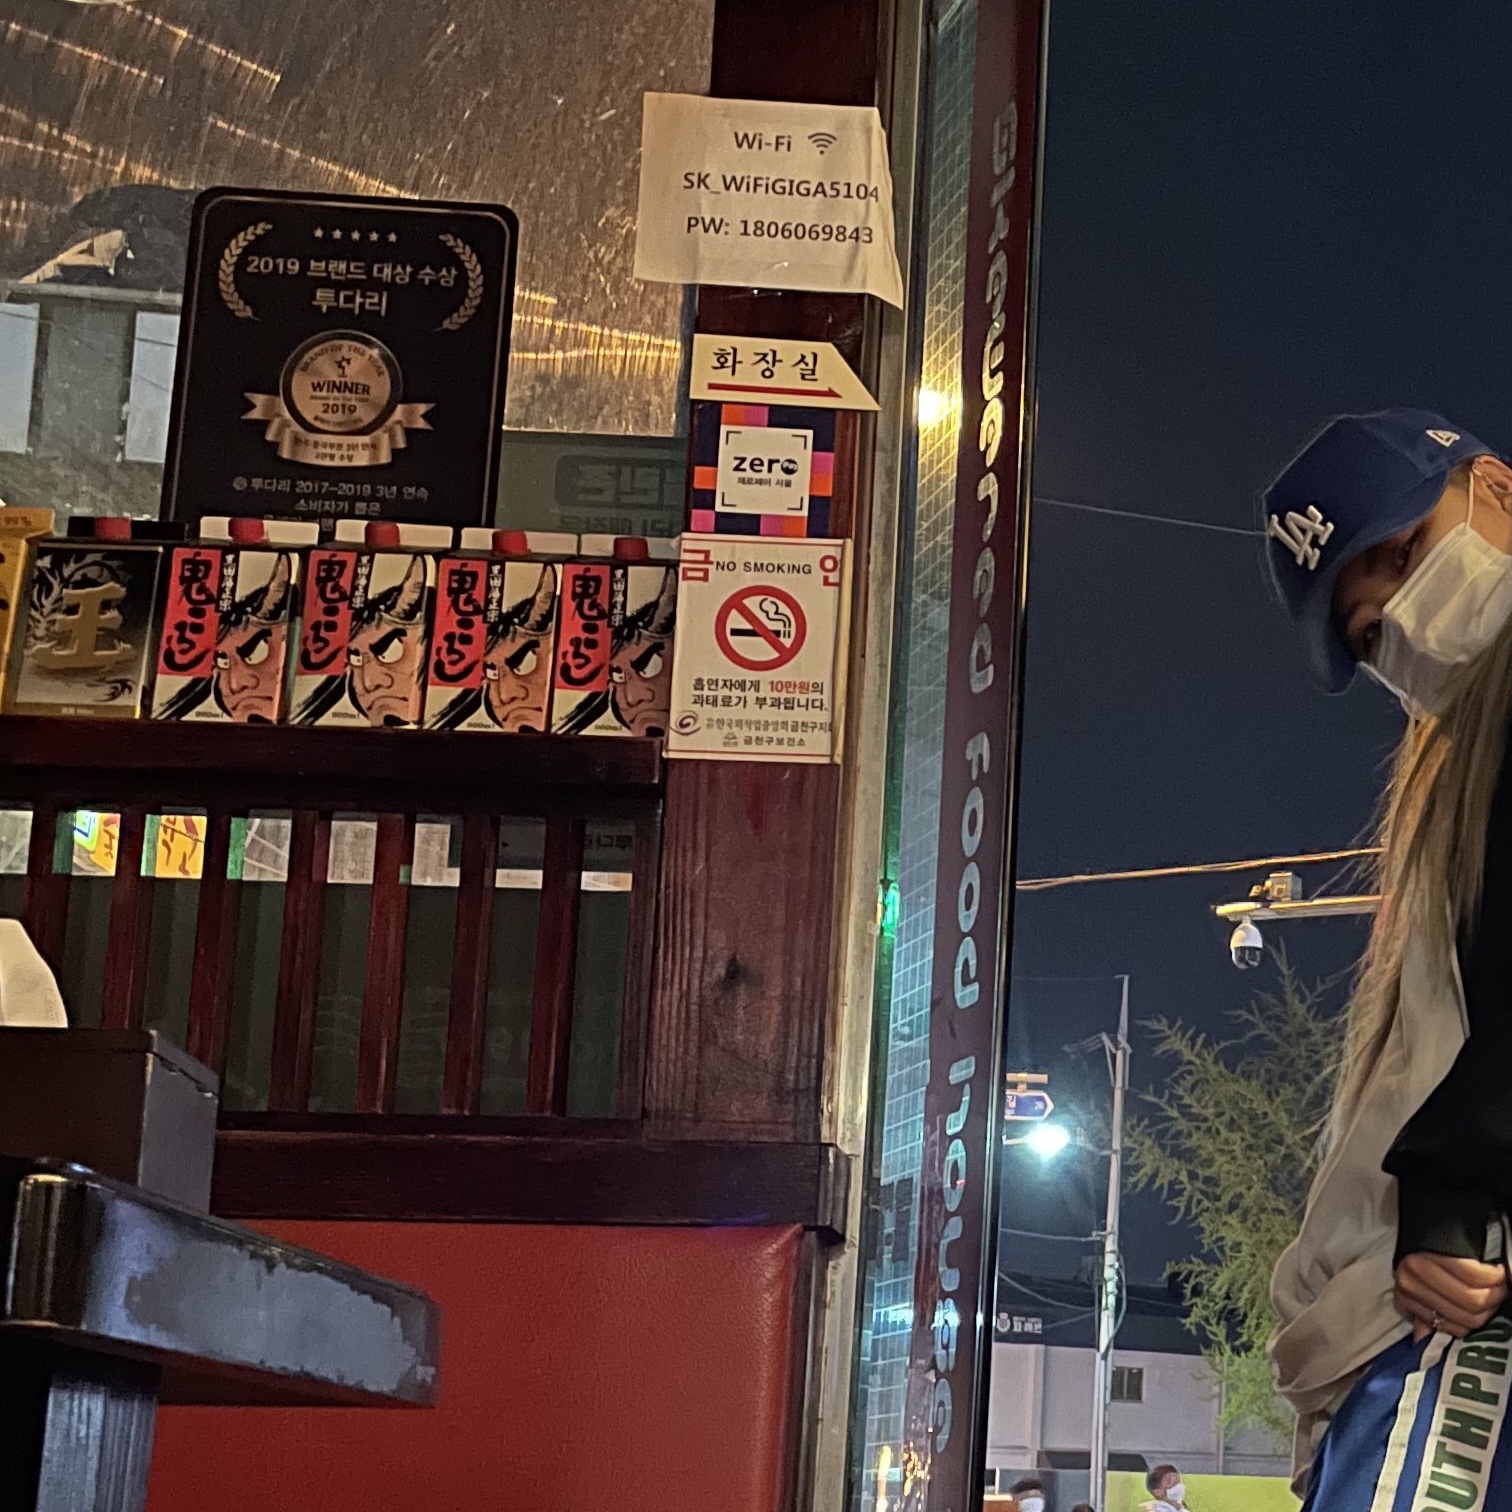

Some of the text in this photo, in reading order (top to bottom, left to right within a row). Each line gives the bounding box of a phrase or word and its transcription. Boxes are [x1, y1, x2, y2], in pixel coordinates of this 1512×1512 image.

[734, 131, 792, 152] Wi-Fi
[683, 172, 879, 203] SK_WiFiGIGA5104
[686, 216, 874, 243] PW: 1806069843
[246, 256, 459, 288] 2019 브랜드 대상 수상
[312, 287, 388, 318] 투다리
[711, 346, 819, 382] 화장실
[311, 379, 371, 396] WINNER
[322, 403, 357, 415] 2019
[251, 478, 291, 492] 투다리
[376, 485, 397, 498] 3년
[295, 499, 349, 514] 소비자가
[1268, 505, 1334, 571] LA
[716, 561, 737, 571] NO
[743, 562, 812, 574] SMOKING
[692, 677, 824, 695] 흡연자에게 10만원의
[692, 694, 747, 709] 과태료가
[743, 736, 806, 747] 금천구보건소
